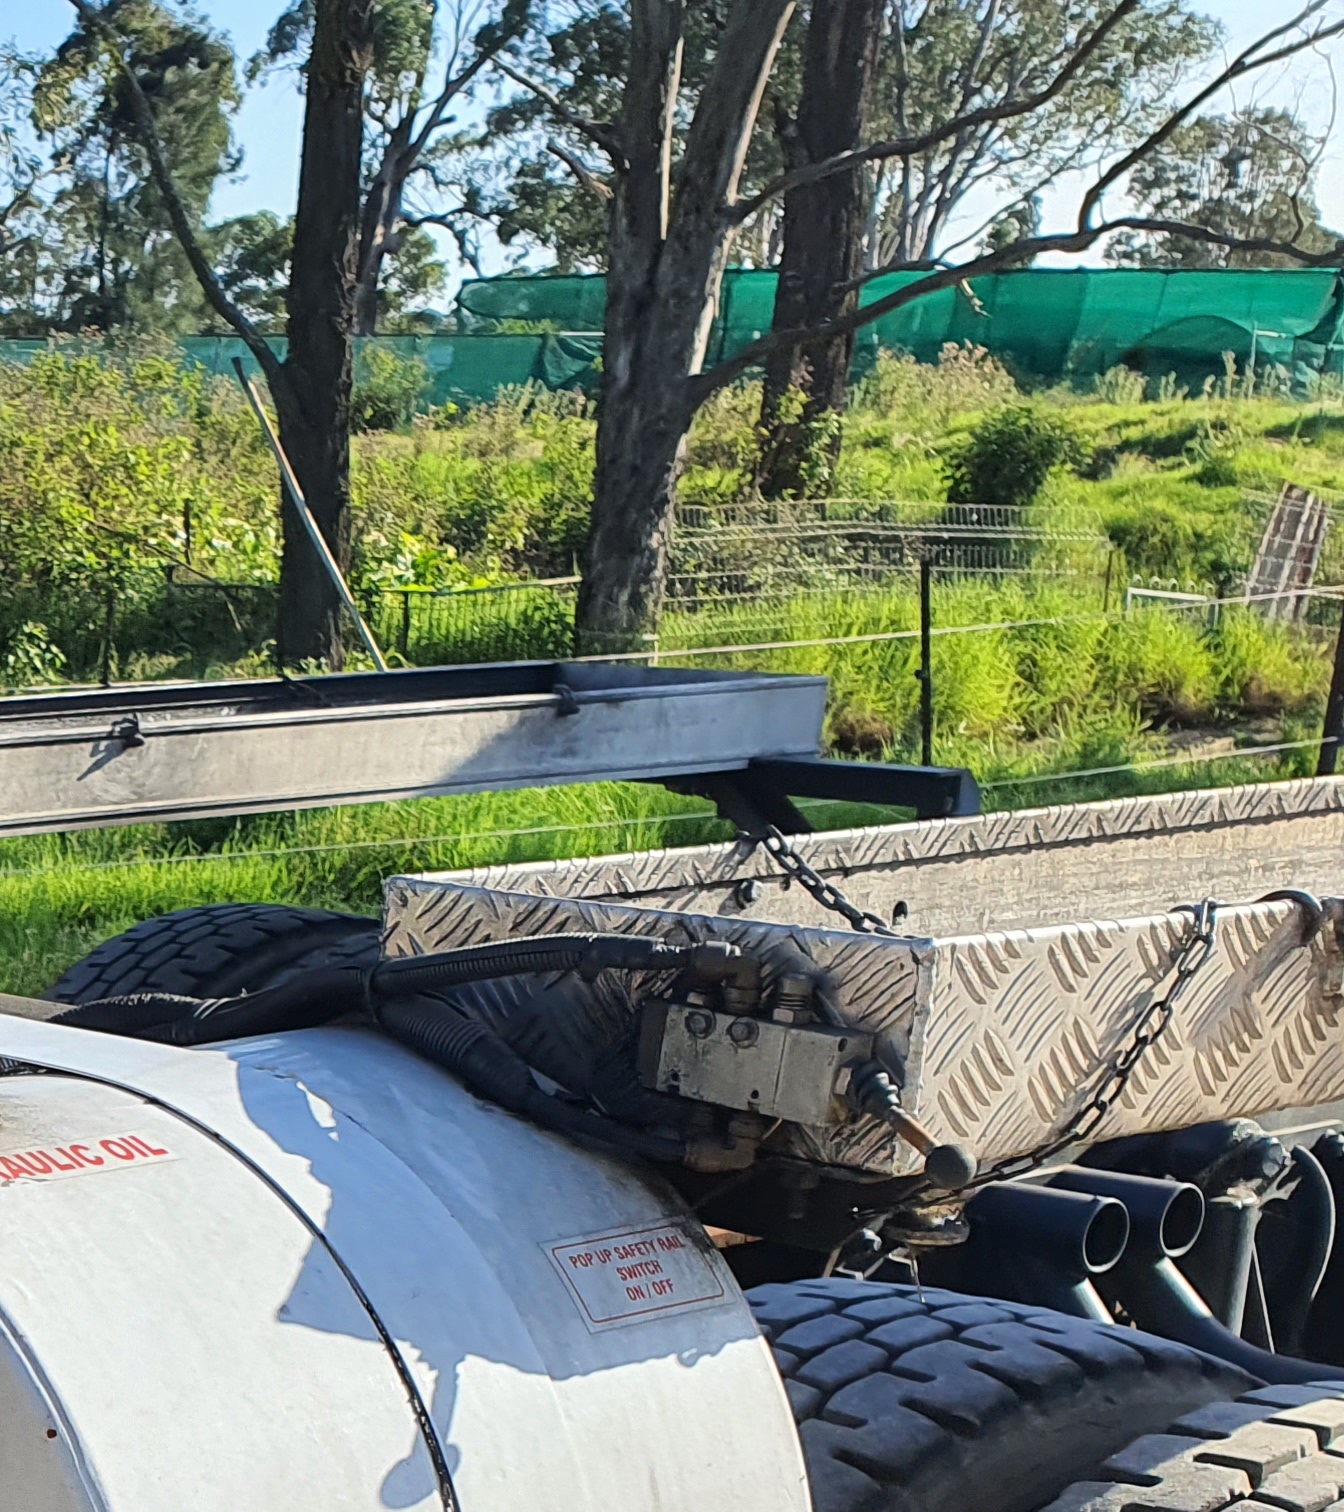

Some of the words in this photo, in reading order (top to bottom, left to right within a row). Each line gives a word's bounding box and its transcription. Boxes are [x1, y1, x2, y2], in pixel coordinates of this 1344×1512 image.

[99, 1135, 169, 1161] OIL
[568, 1253, 594, 1269] POP
[596, 1249, 612, 1265] UP
[613, 1239, 656, 1260] SAFETY
[658, 1234, 687, 1253] RAIL
[615, 1259, 664, 1282] SWITCH
[626, 1285, 645, 1302] ON
[652, 1278, 674, 1296] OFF
